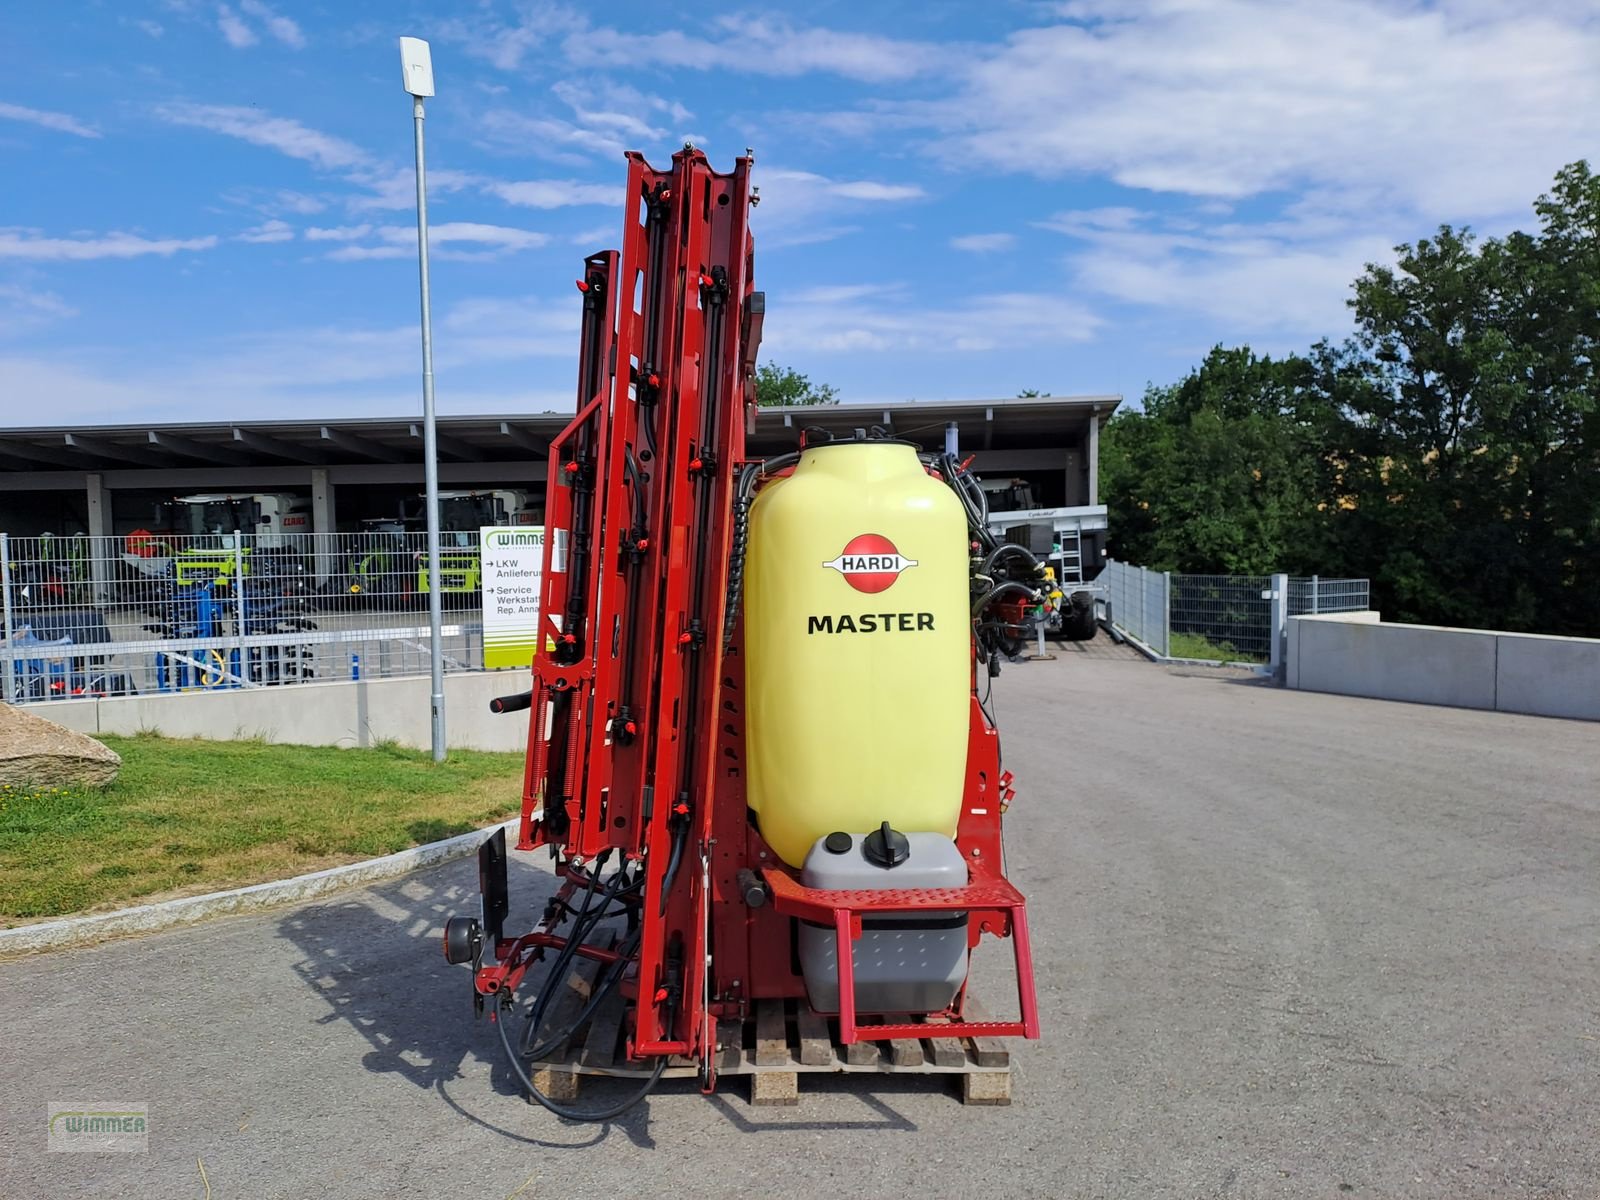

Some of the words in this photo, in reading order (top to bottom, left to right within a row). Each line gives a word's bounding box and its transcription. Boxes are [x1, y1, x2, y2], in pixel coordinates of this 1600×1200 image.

[496, 560, 518, 568] LKW
[842, 557, 899, 570] HARDI
[496, 586, 532, 594] Service
[497, 606, 516, 615] Rep.
[808, 612, 935, 635] MASTER
